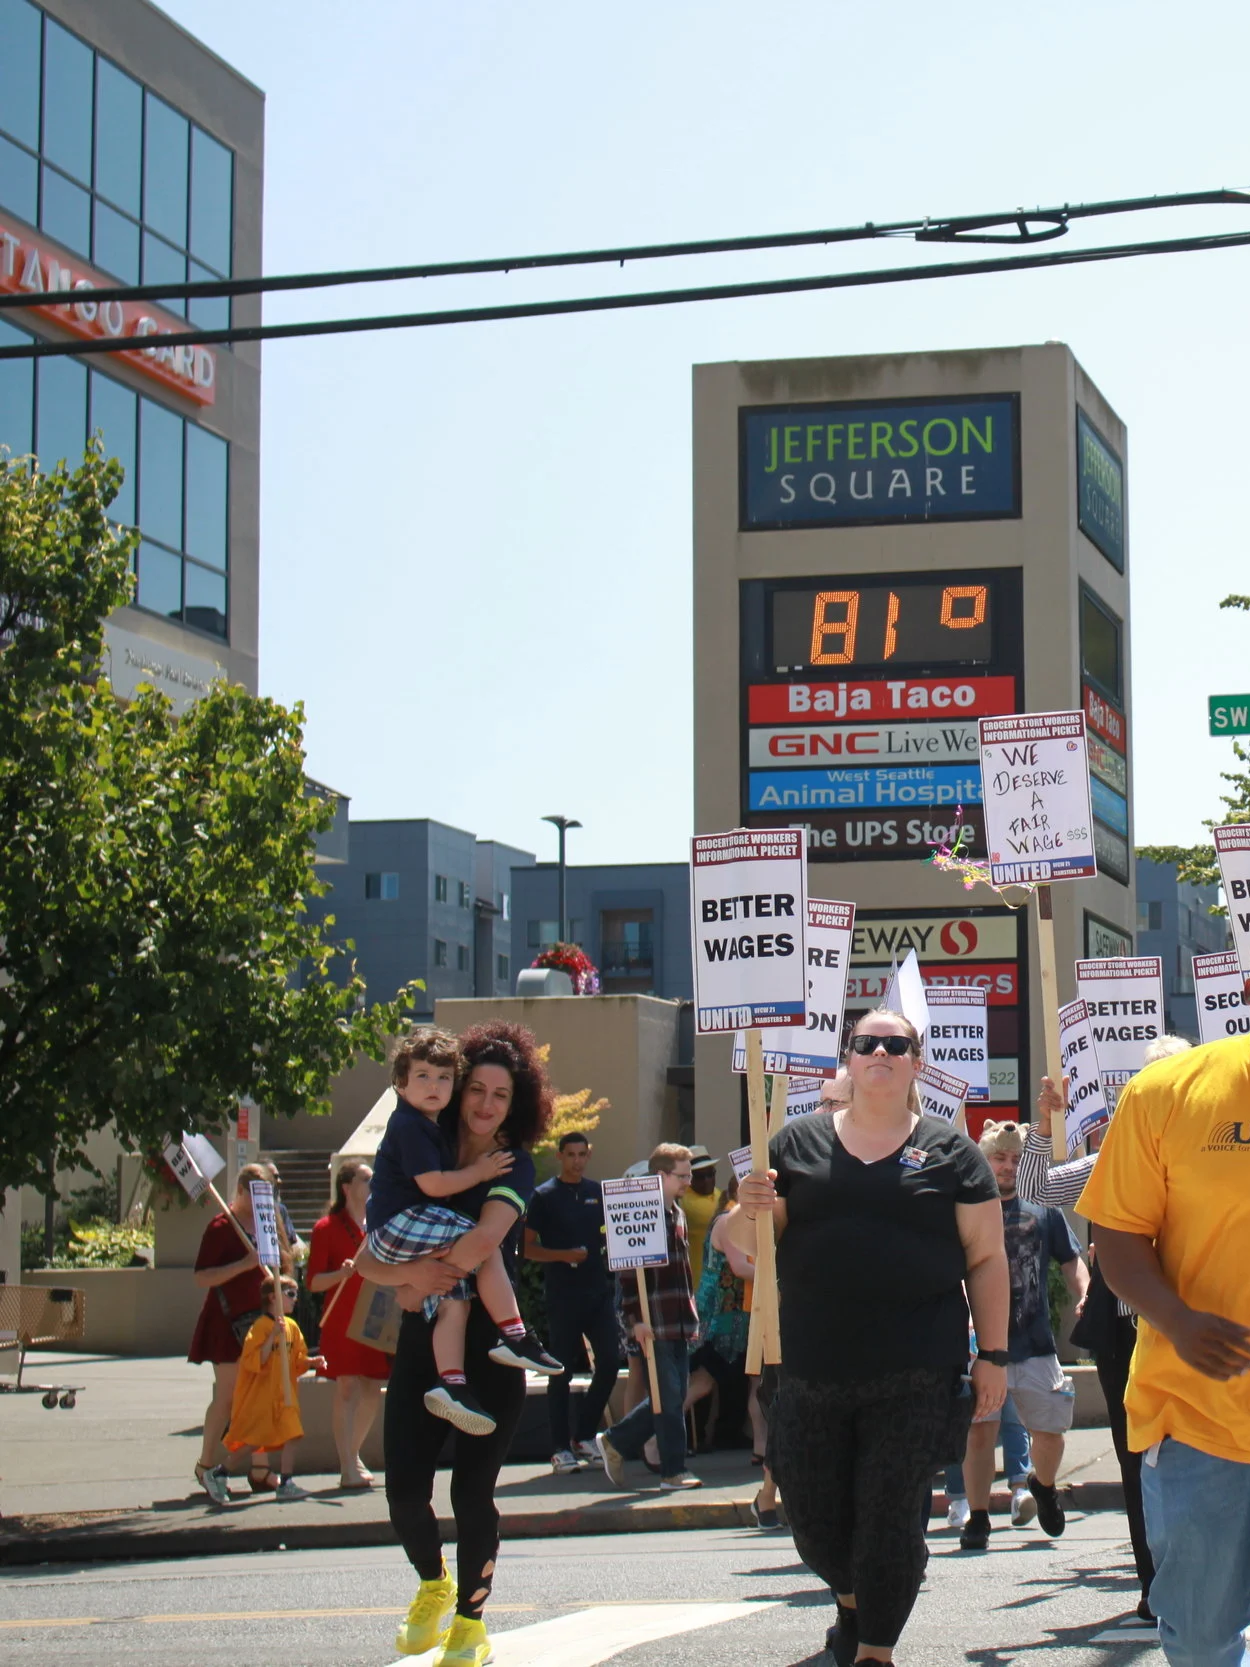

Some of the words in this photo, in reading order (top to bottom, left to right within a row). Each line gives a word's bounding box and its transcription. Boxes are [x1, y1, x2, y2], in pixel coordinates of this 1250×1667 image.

[2, 232, 124, 337] TANGO
[136, 316, 214, 388] CARD
[765, 416, 993, 472] JEFFERSON
[780, 466, 976, 504] SQUARE
[788, 682, 871, 717] Baja
[887, 682, 976, 709] Taco
[983, 718, 1018, 731] GROCERY
[1019, 716, 1044, 729] STORE
[1044, 715, 1080, 727] WORKERS
[1214, 706, 1248, 729] SW
[768, 731, 880, 757] GNC
[885, 729, 978, 754] LiveWe
[984, 728, 1051, 742] INFORMATIONAL
[1052, 725, 1081, 737] PICKET
[1002, 743, 1039, 766] WE
[827, 770, 871, 782] West
[875, 768, 935, 781] Seattle
[993, 770, 1068, 795] DESERVE
[758, 783, 864, 806] Animal
[875, 779, 983, 804] Hospit
[1031, 792, 1044, 811] A
[789, 822, 837, 846] he
[845, 820, 898, 846] UPS
[906, 819, 976, 845] Store
[1009, 814, 1051, 836] FAIR
[1217, 827, 1244, 839] GROCERY
[728, 834, 750, 846] TORE
[751, 833, 797, 844] WORKERS
[1006, 832, 1063, 855] WAGE
[697, 846, 759, 863] INFORMIONAL
[760, 844, 798, 856] PICKET
[994, 862, 1051, 884] UNITED
[702, 893, 795, 922] BETTER
[809, 902, 850, 916] WORKERS
[816, 914, 849, 927] PICKET
[704, 933, 795, 962] WAGES
[851, 926, 934, 954] EWAY
[1079, 961, 1106, 970] GROCERY
[1107, 960, 1127, 969] STORE
[1127, 959, 1157, 968] WORKERS
[1196, 955, 1225, 967] GROCERY
[1226, 954, 1238, 963] STO
[1197, 964, 1239, 976] INFORMATIO
[1080, 968, 1133, 978] INFORMATIONAL
[1134, 967, 1157, 976] PICKET
[920, 974, 1013, 994] RUGS
[1087, 999, 1157, 1016] BETTER
[1204, 991, 1247, 1011] SEC
[700, 1006, 752, 1031] UNITED
[931, 1025, 984, 1039] BETTER
[1092, 1025, 1158, 1041] WAGES
[735, 1050, 788, 1072] UED
[932, 1048, 985, 1061] WAGES
[1061, 1036, 1089, 1069] CURE
[1102, 1071, 1130, 1087] ITED
[786, 1101, 818, 1117] ECURE
[922, 1096, 955, 1119] TAIN
[1065, 1079, 1100, 1120] NION
[1207, 1144, 1236, 1152] VOICE
[606, 1199, 660, 1211] SCHEDULING
[610, 1212, 630, 1223] WE
[633, 1209, 658, 1222] CAN
[615, 1222, 657, 1236] COUNT
[628, 1237, 646, 1248] ON
[611, 1257, 644, 1269] UNITED
